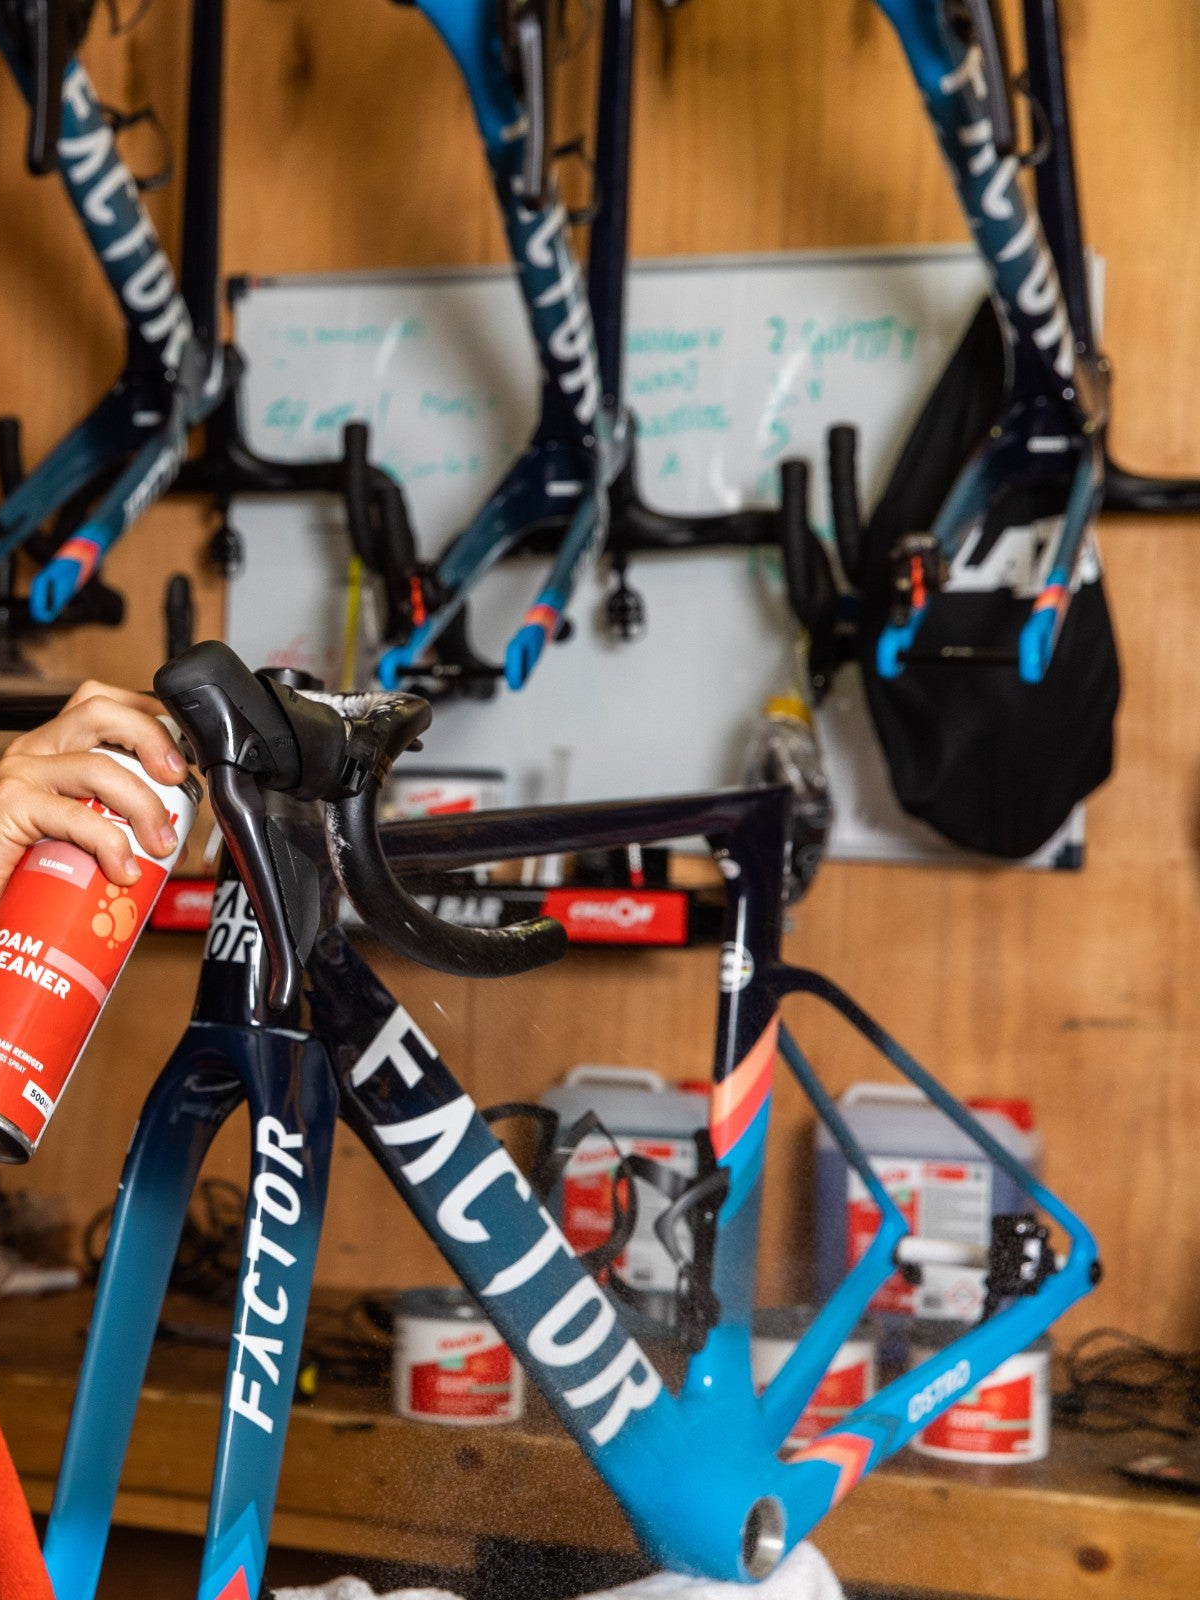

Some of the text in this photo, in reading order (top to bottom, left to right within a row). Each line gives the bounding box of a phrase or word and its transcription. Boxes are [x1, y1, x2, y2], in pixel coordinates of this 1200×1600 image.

[38, 857, 74, 875] CLEANING
[7, 1058, 27, 1073] SPRAY
[12, 1046, 44, 1072] REINIGER
[351, 1004, 664, 1447] FACTOR
[228, 1115, 303, 1434] FACTOR
